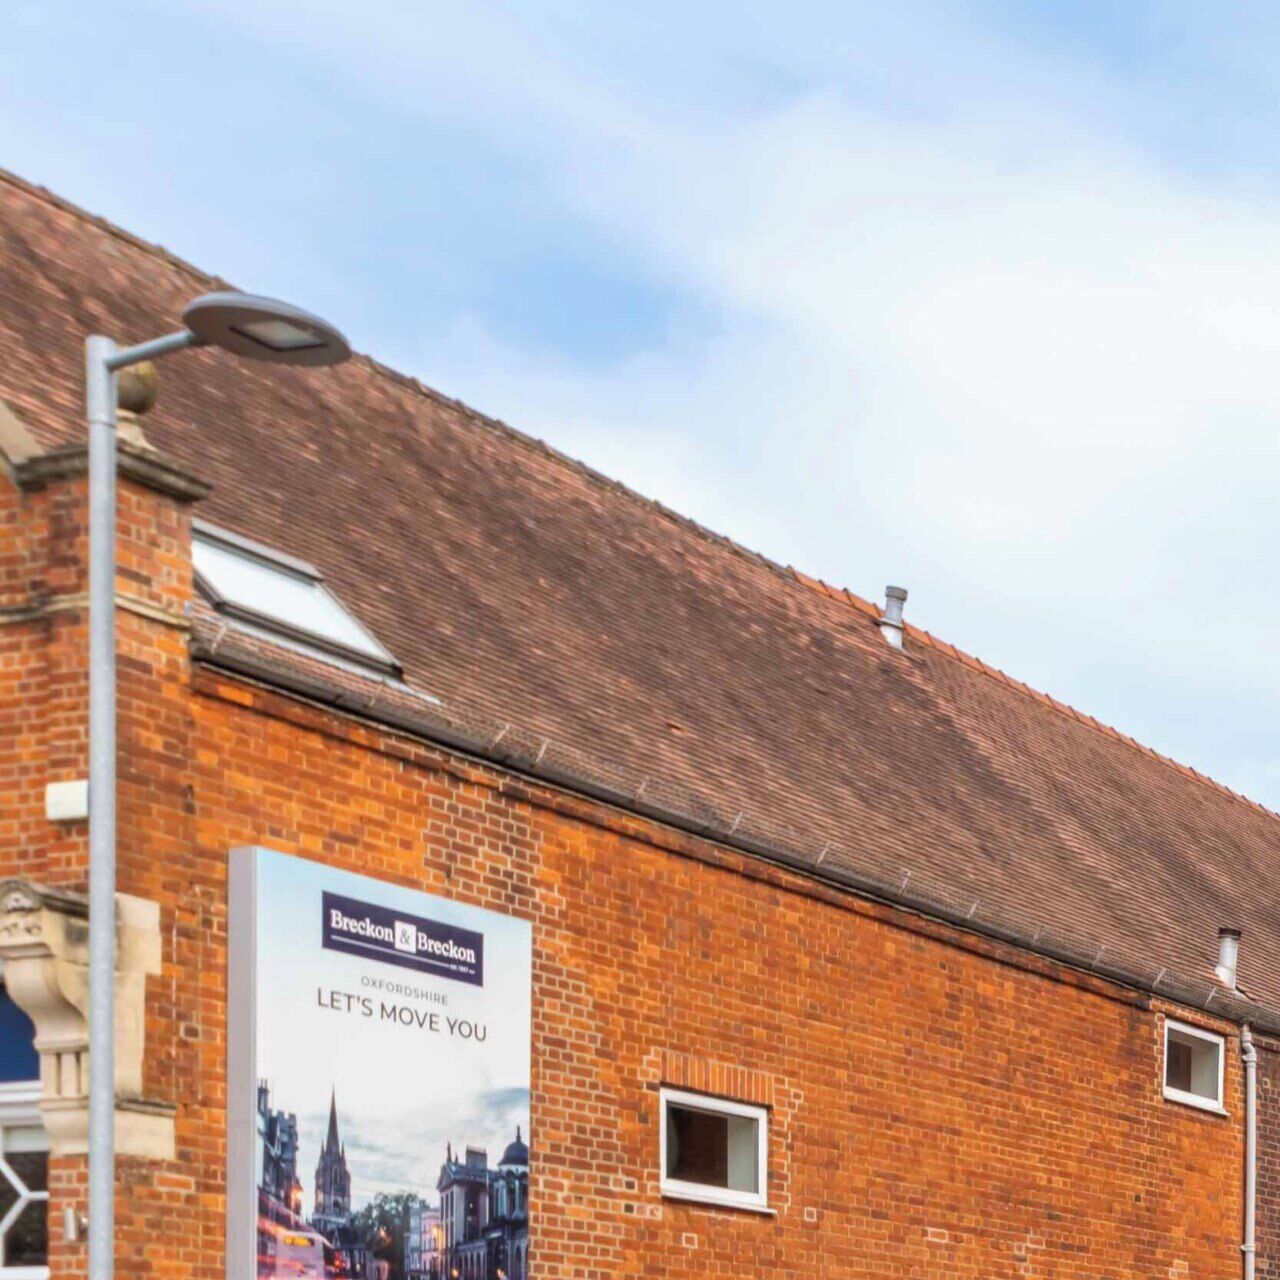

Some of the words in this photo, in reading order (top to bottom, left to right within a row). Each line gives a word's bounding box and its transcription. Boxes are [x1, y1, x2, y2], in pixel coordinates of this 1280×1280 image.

[330, 909, 394, 942] Breckon
[399, 928, 411, 945] &
[417, 932, 476, 963] Breckon
[317, 988, 373, 1017] LET'S
[381, 1002, 440, 1032] MOVE
[446, 1016, 487, 1042] YOU
[361, 975, 448, 1006] OXFORDSHIRE
